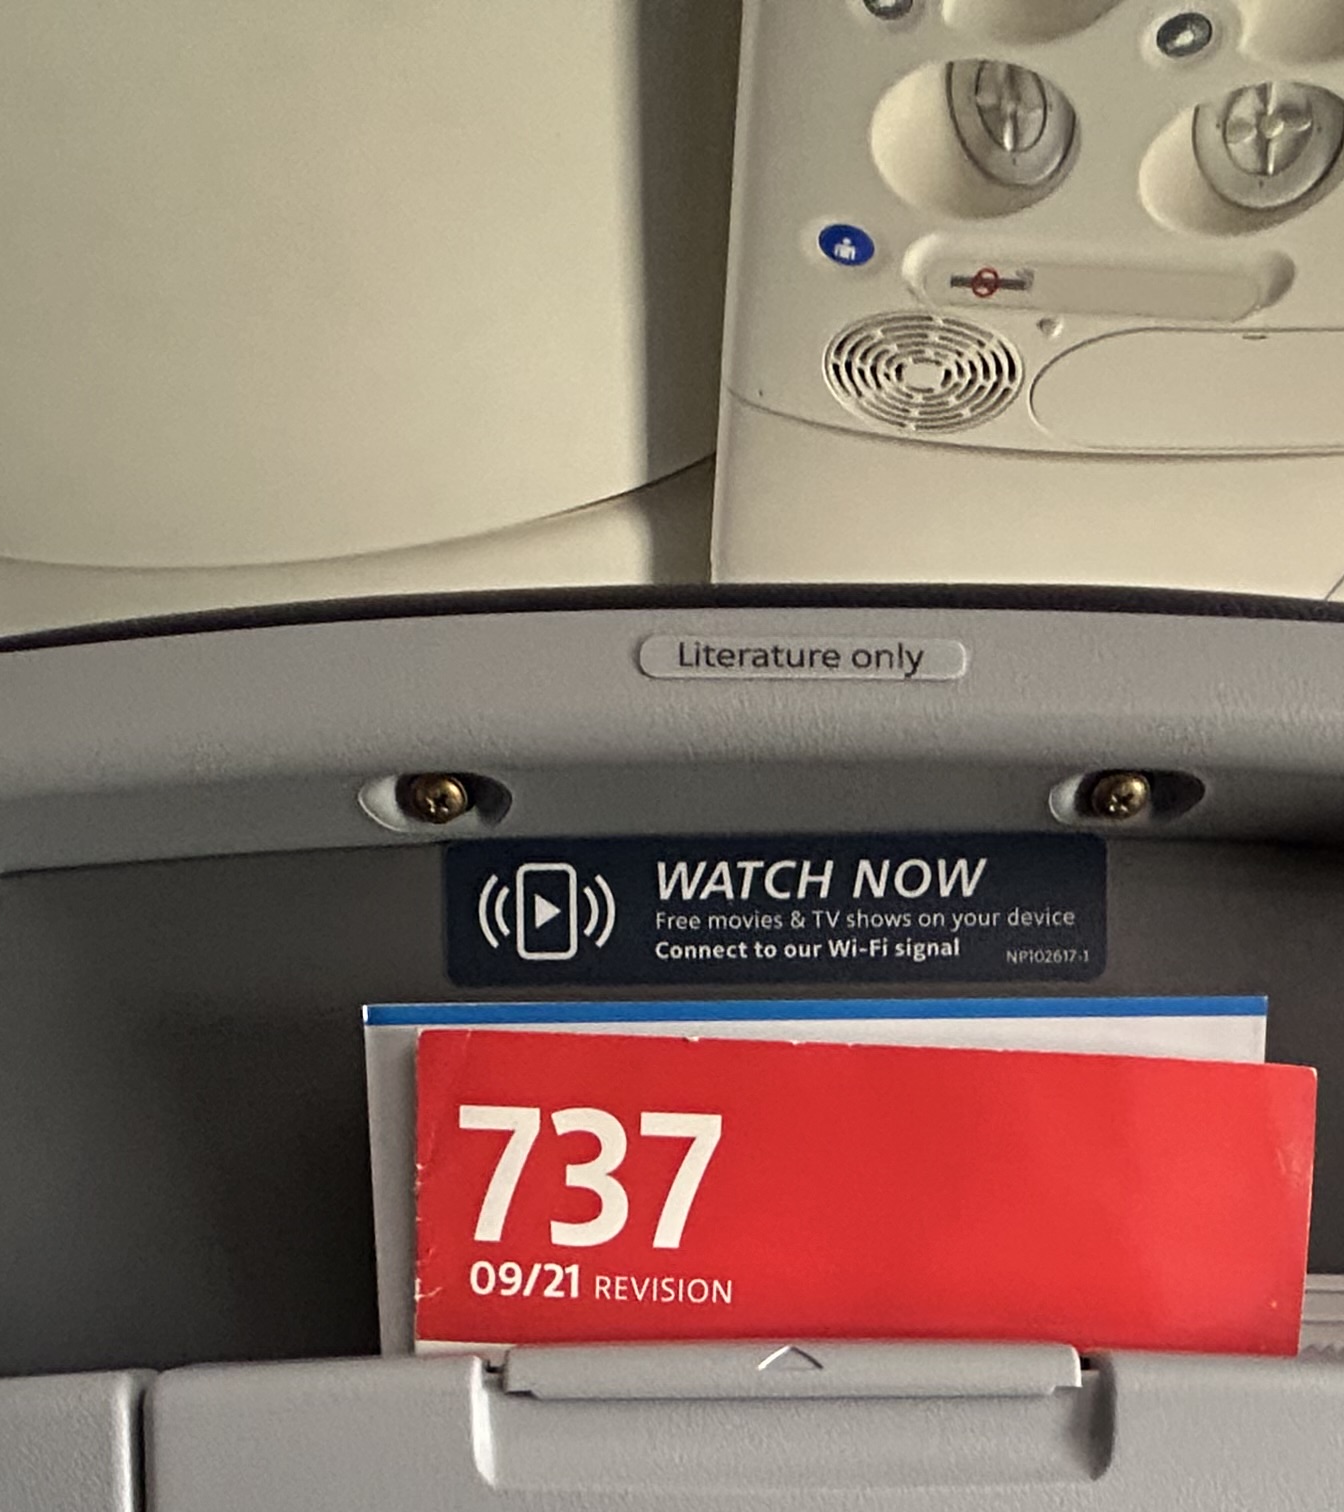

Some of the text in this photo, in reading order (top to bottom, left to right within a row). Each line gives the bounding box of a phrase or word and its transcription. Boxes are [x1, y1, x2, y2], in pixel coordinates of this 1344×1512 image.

[678, 641, 924, 678] Literature only
[656, 858, 987, 900] WATCH NOW
[656, 907, 1075, 934] Free movies & TV shows on your device
[655, 936, 960, 962] Connect to our Wi-Fi signal
[459, 1104, 723, 1249] 737
[469, 1260, 733, 1304] 09/21 REVISION
